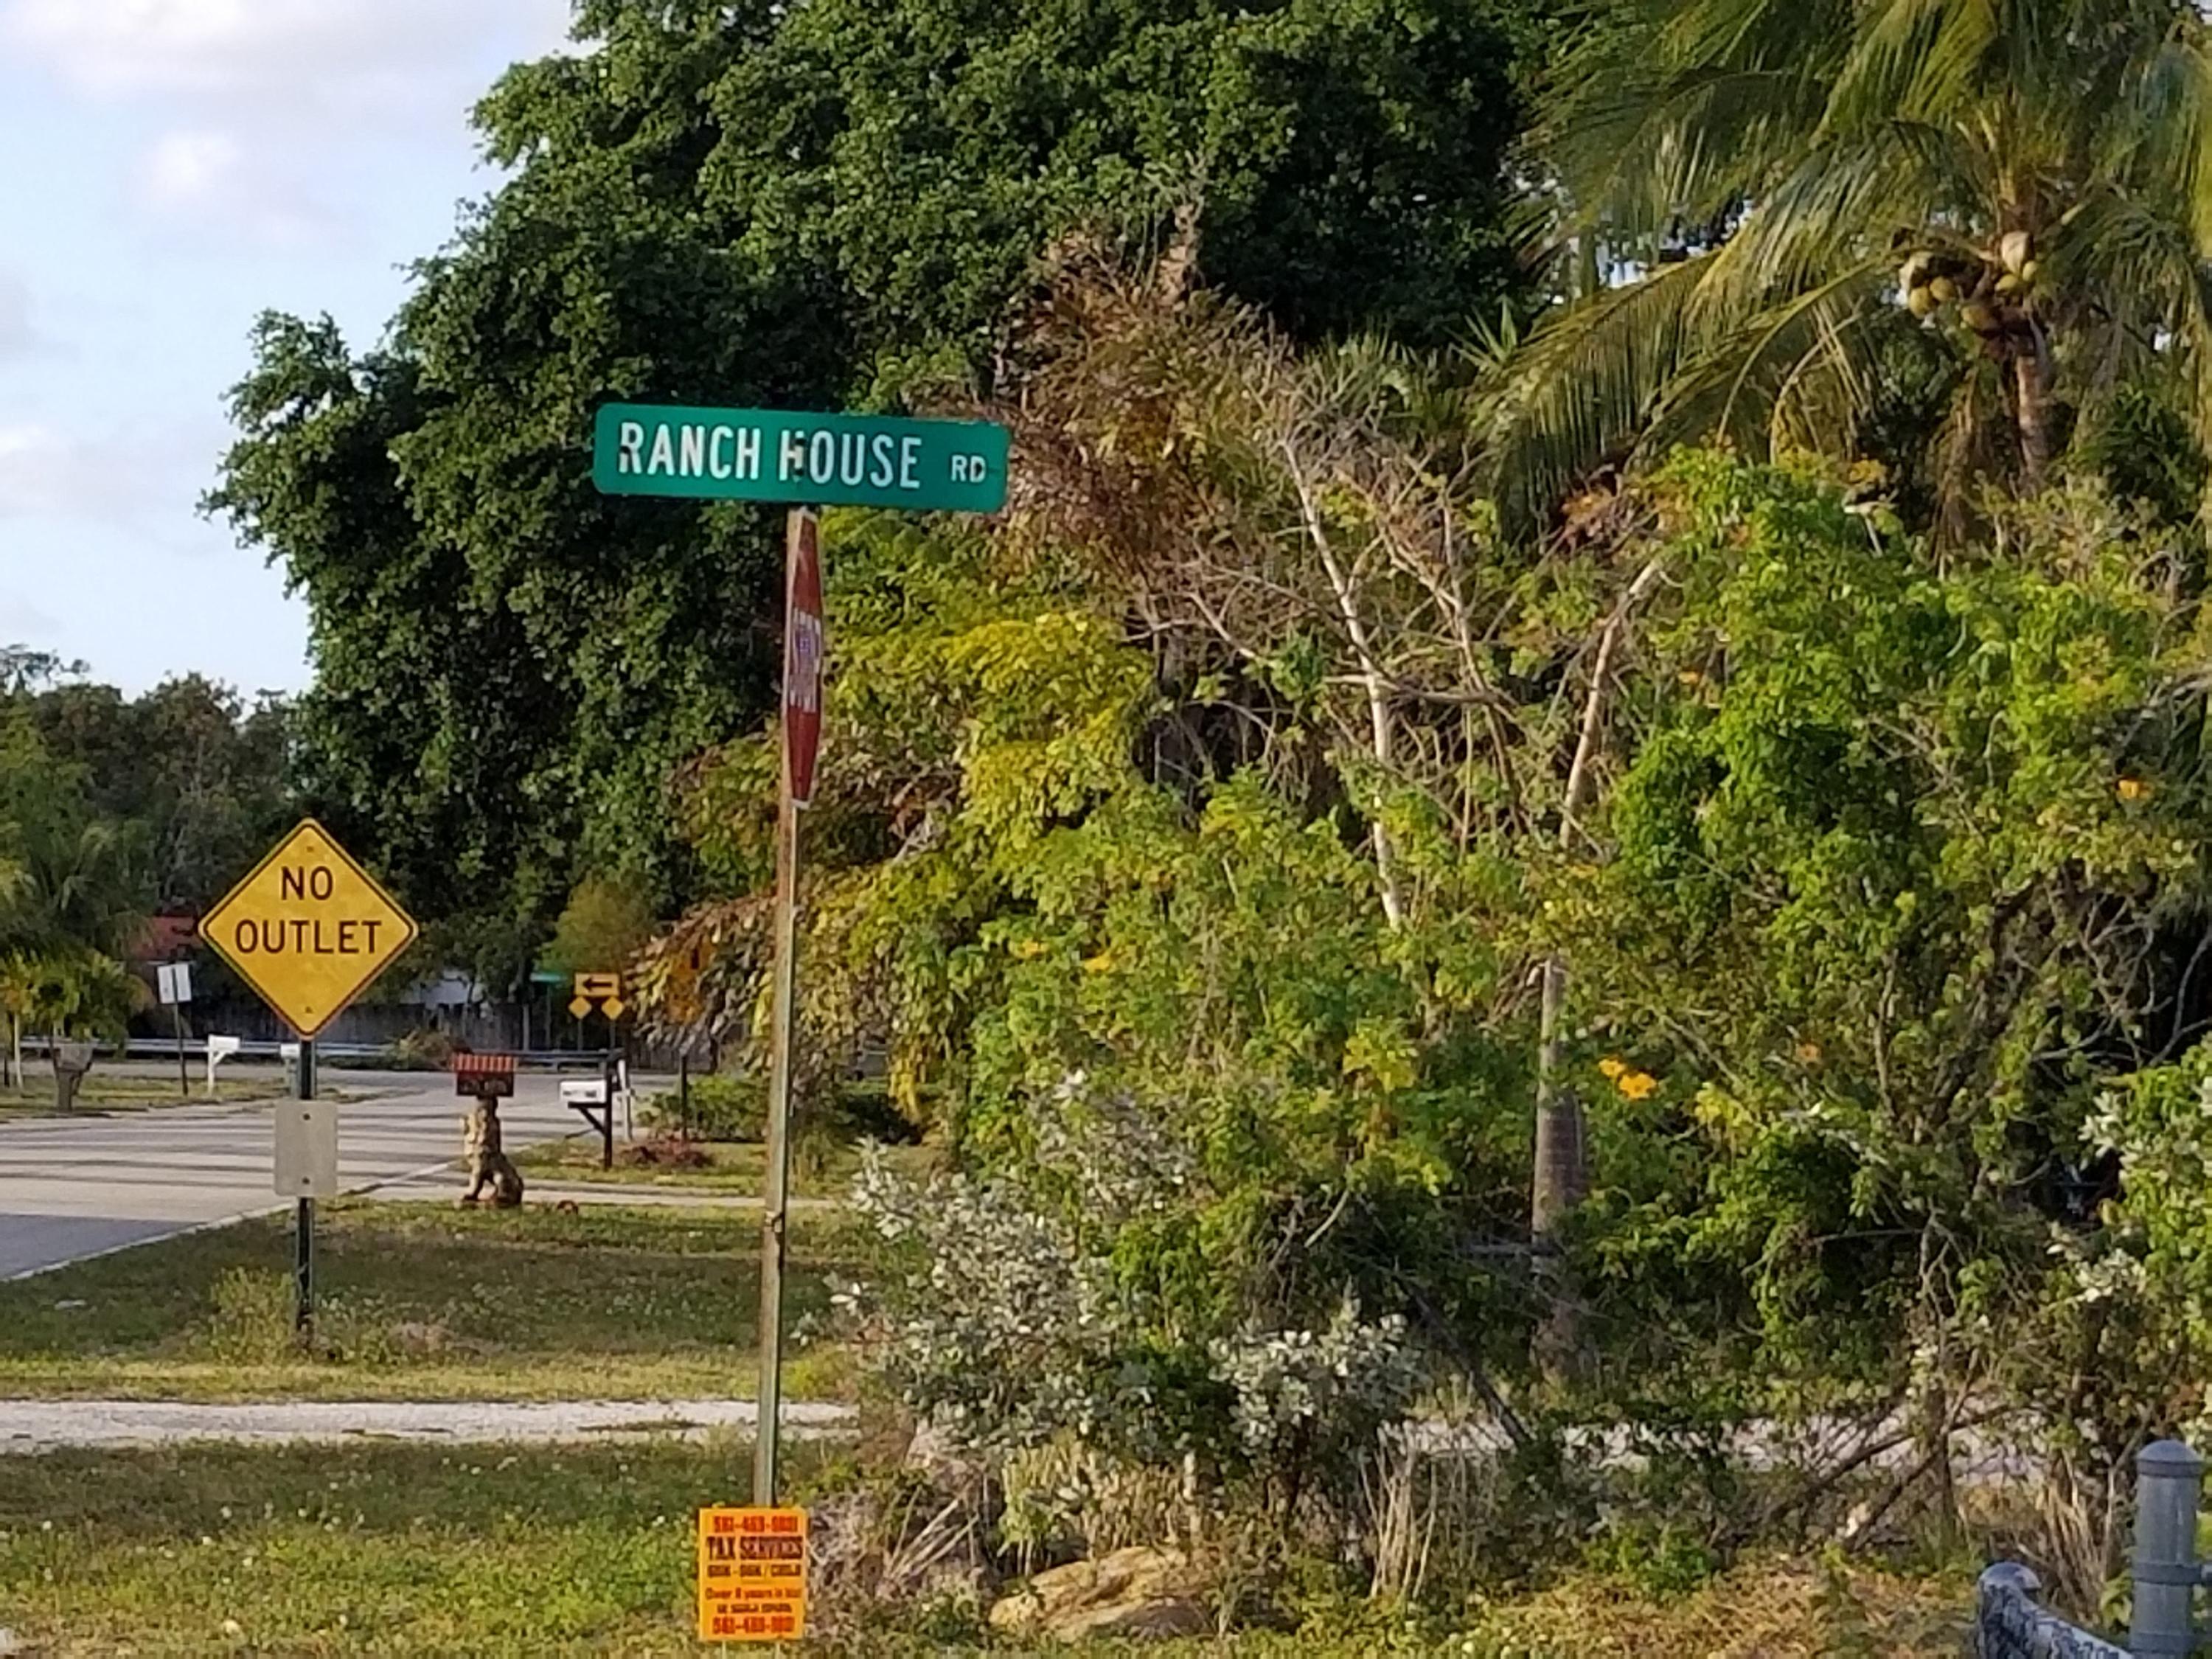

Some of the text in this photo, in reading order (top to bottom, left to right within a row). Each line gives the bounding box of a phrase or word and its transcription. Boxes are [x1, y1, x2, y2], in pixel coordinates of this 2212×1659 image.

[619, 422, 987, 488] RANCH HOUSE RD
[282, 866, 333, 900] NO
[235, 919, 382, 953] OUTLET
[707, 1536, 736, 1560] TAX
